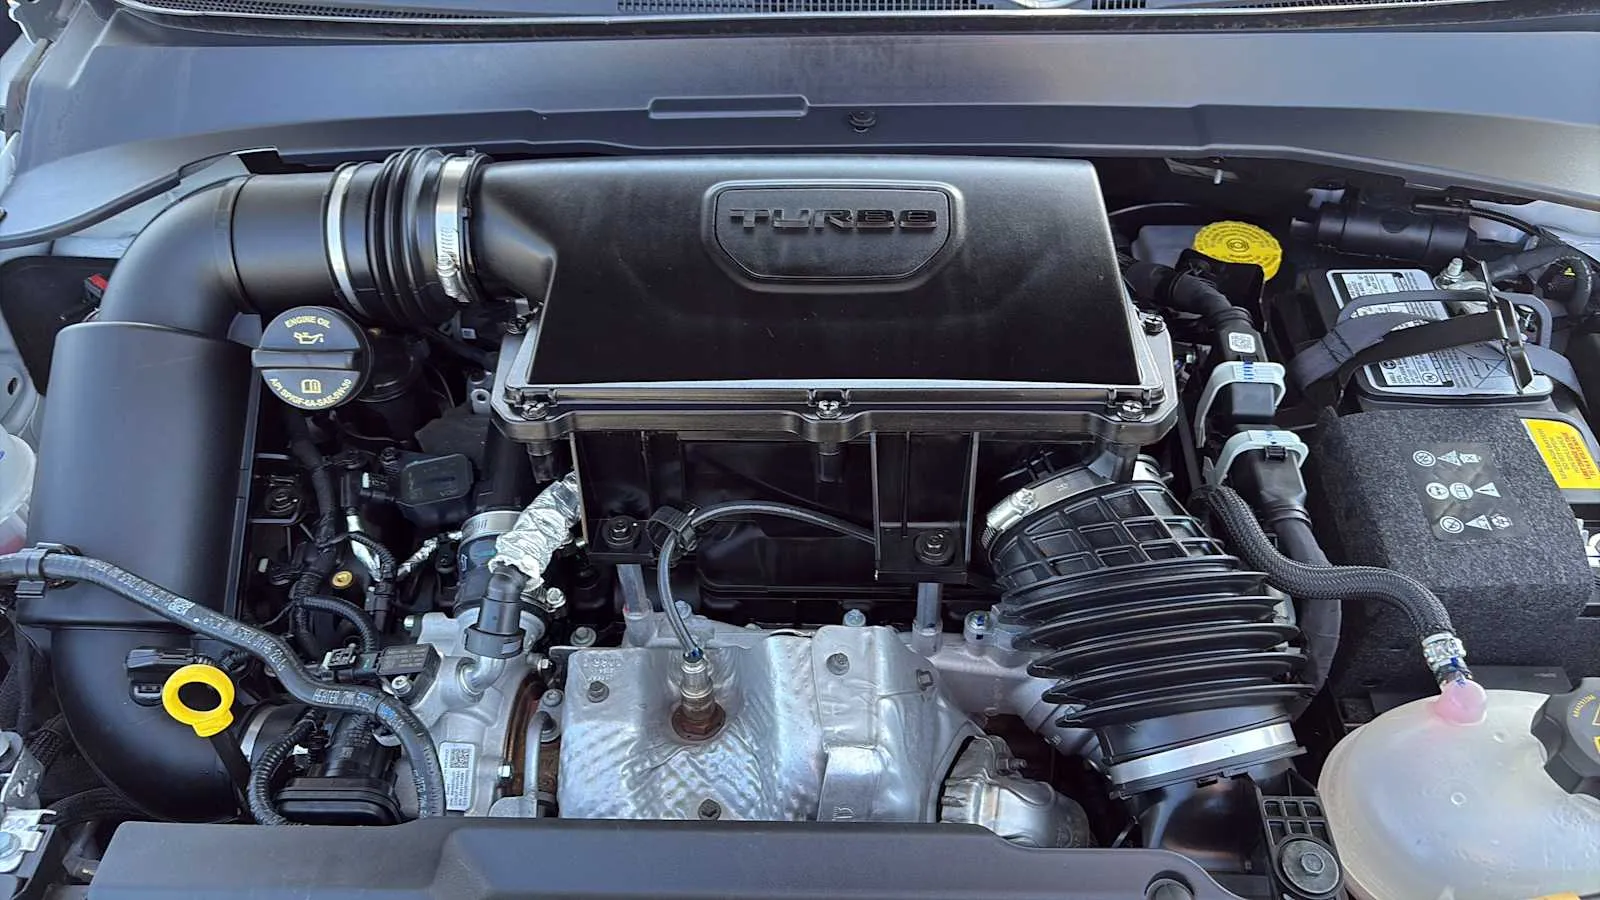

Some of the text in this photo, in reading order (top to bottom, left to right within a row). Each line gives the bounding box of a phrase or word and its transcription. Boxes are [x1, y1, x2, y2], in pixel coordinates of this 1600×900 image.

[728, 208, 937, 230] TURBO
[284, 315, 331, 329] ENGINE OIL
